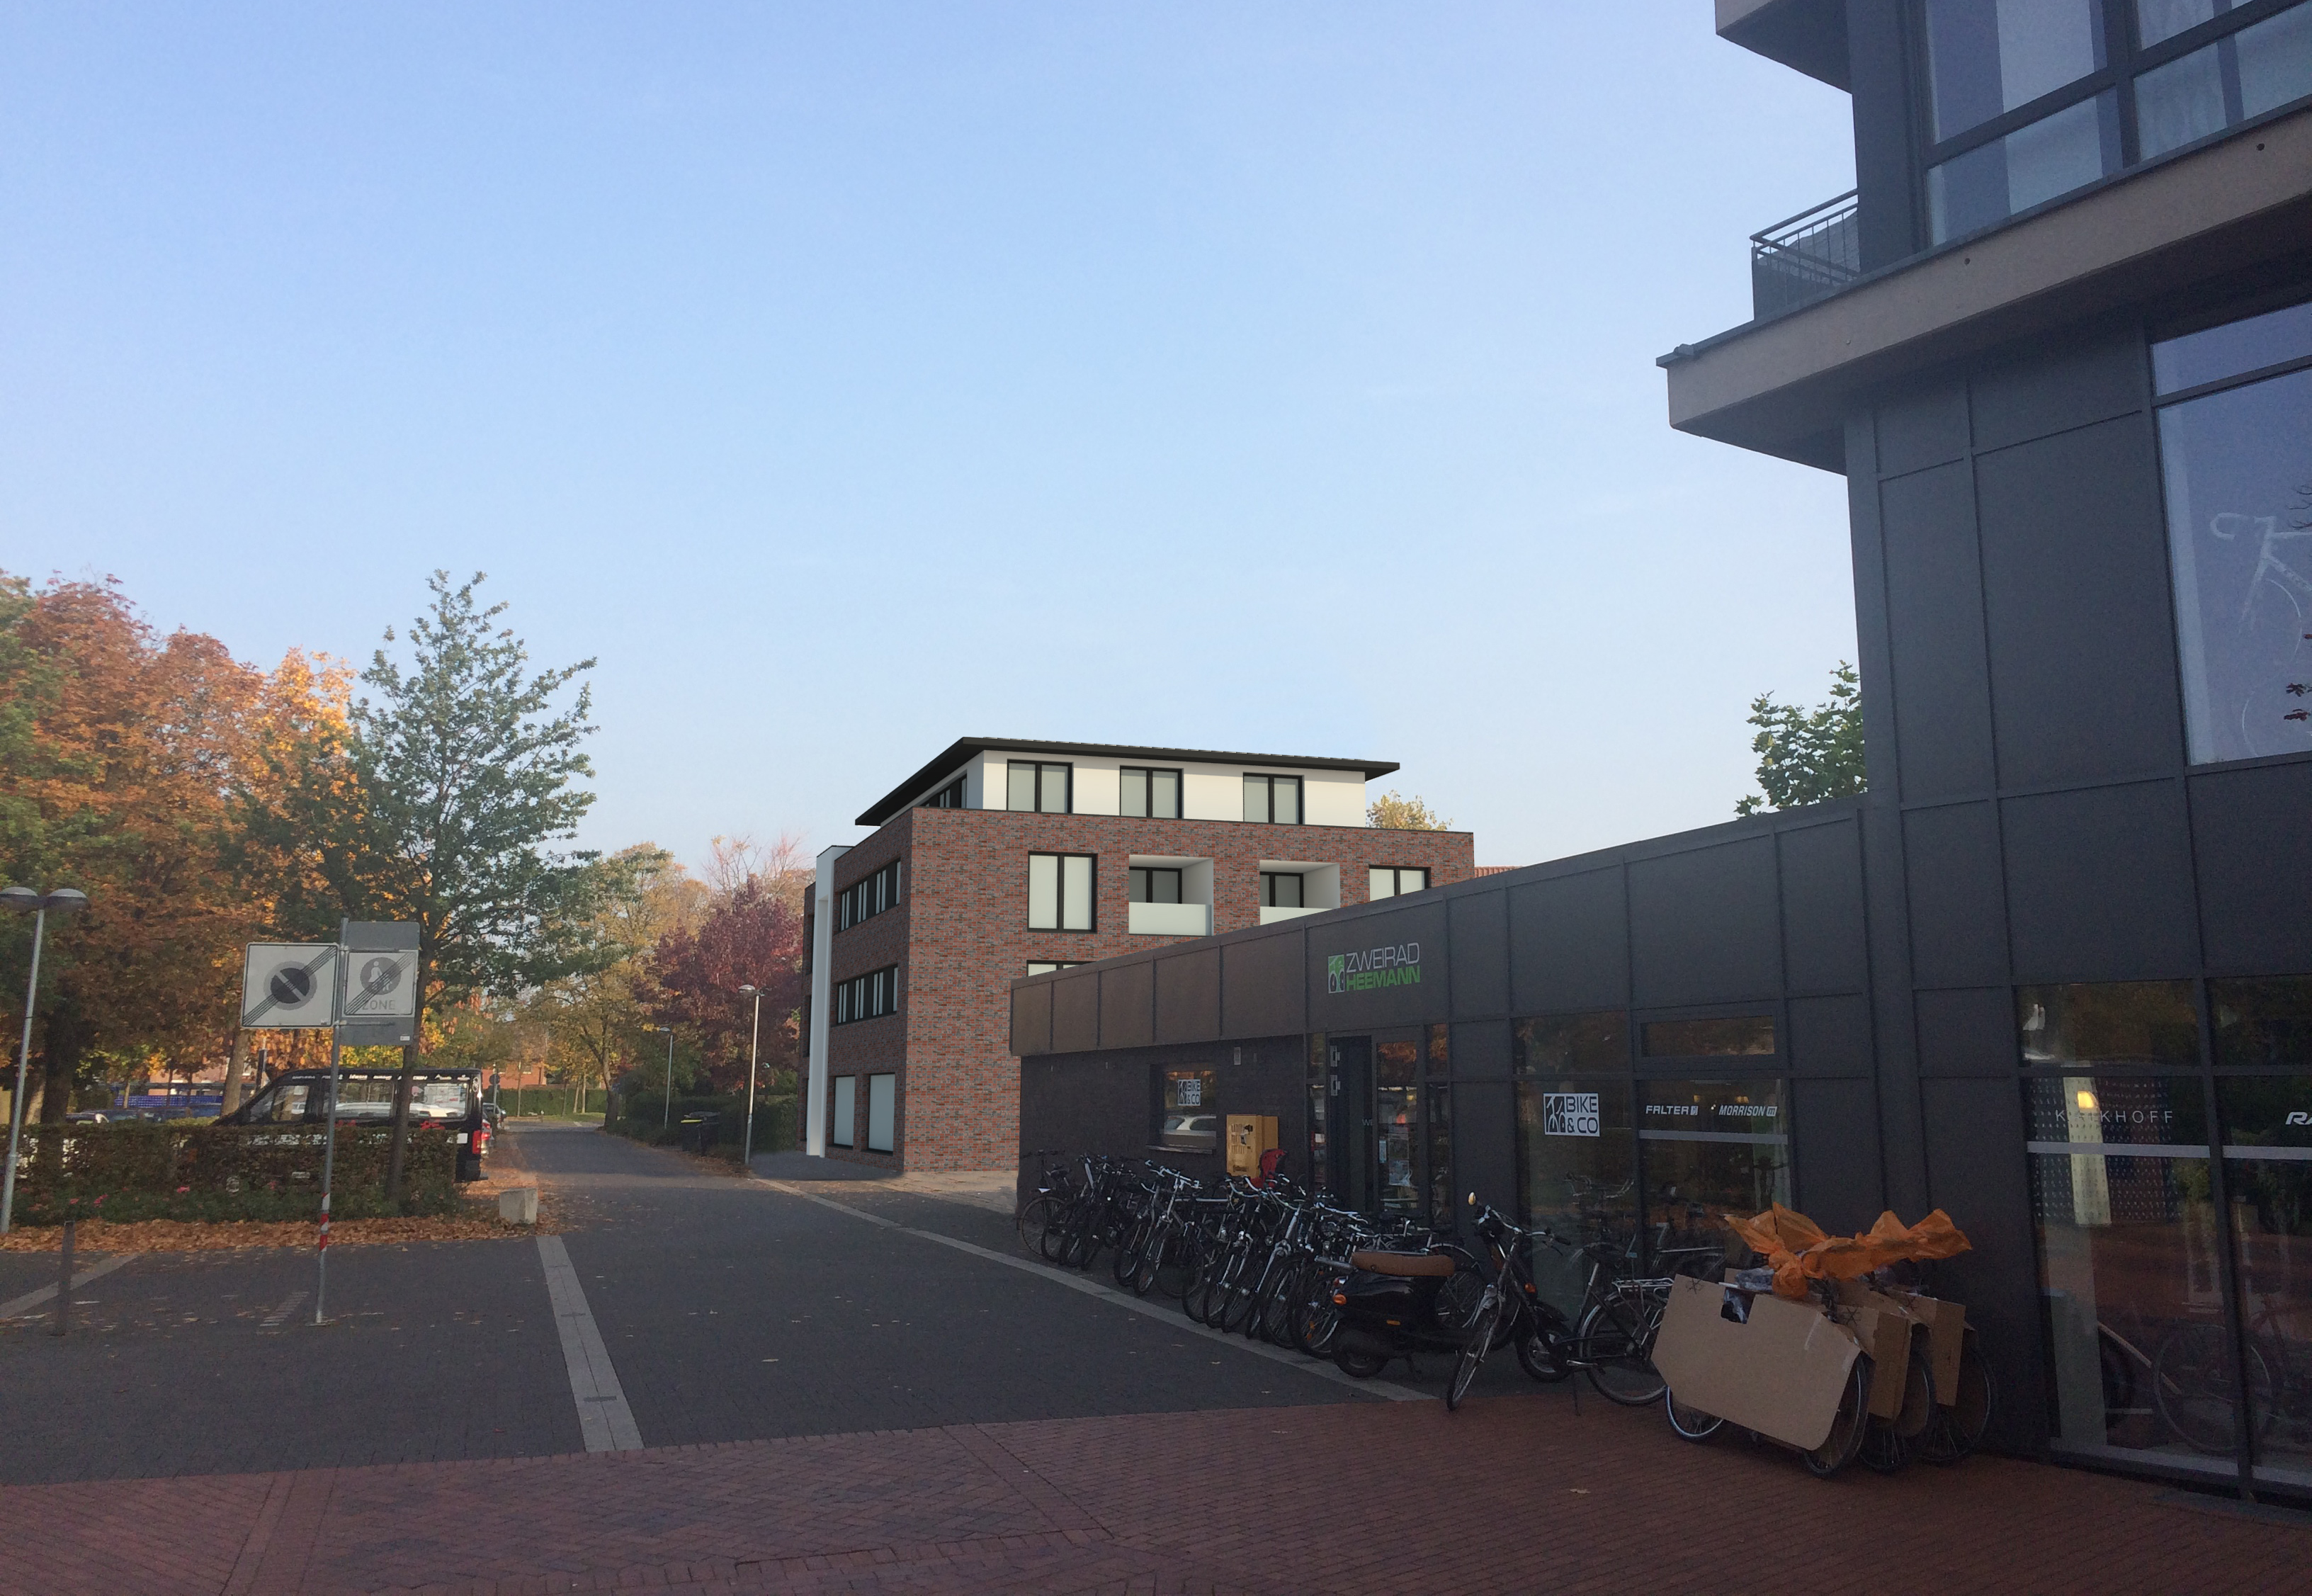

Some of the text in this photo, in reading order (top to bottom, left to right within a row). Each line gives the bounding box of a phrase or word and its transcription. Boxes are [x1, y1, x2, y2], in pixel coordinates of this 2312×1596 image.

[1346, 942, 1420, 973] ZWEIRAD
[1346, 965, 1420, 992] HEEMANN
[362, 1000, 396, 1010] ZONE
[1565, 1096, 1597, 1113] BIKE
[1645, 1105, 1689, 1115] FALTER
[1718, 1105, 1765, 1116] MORRISON
[2056, 1109, 2172, 1124] KKHOFF
